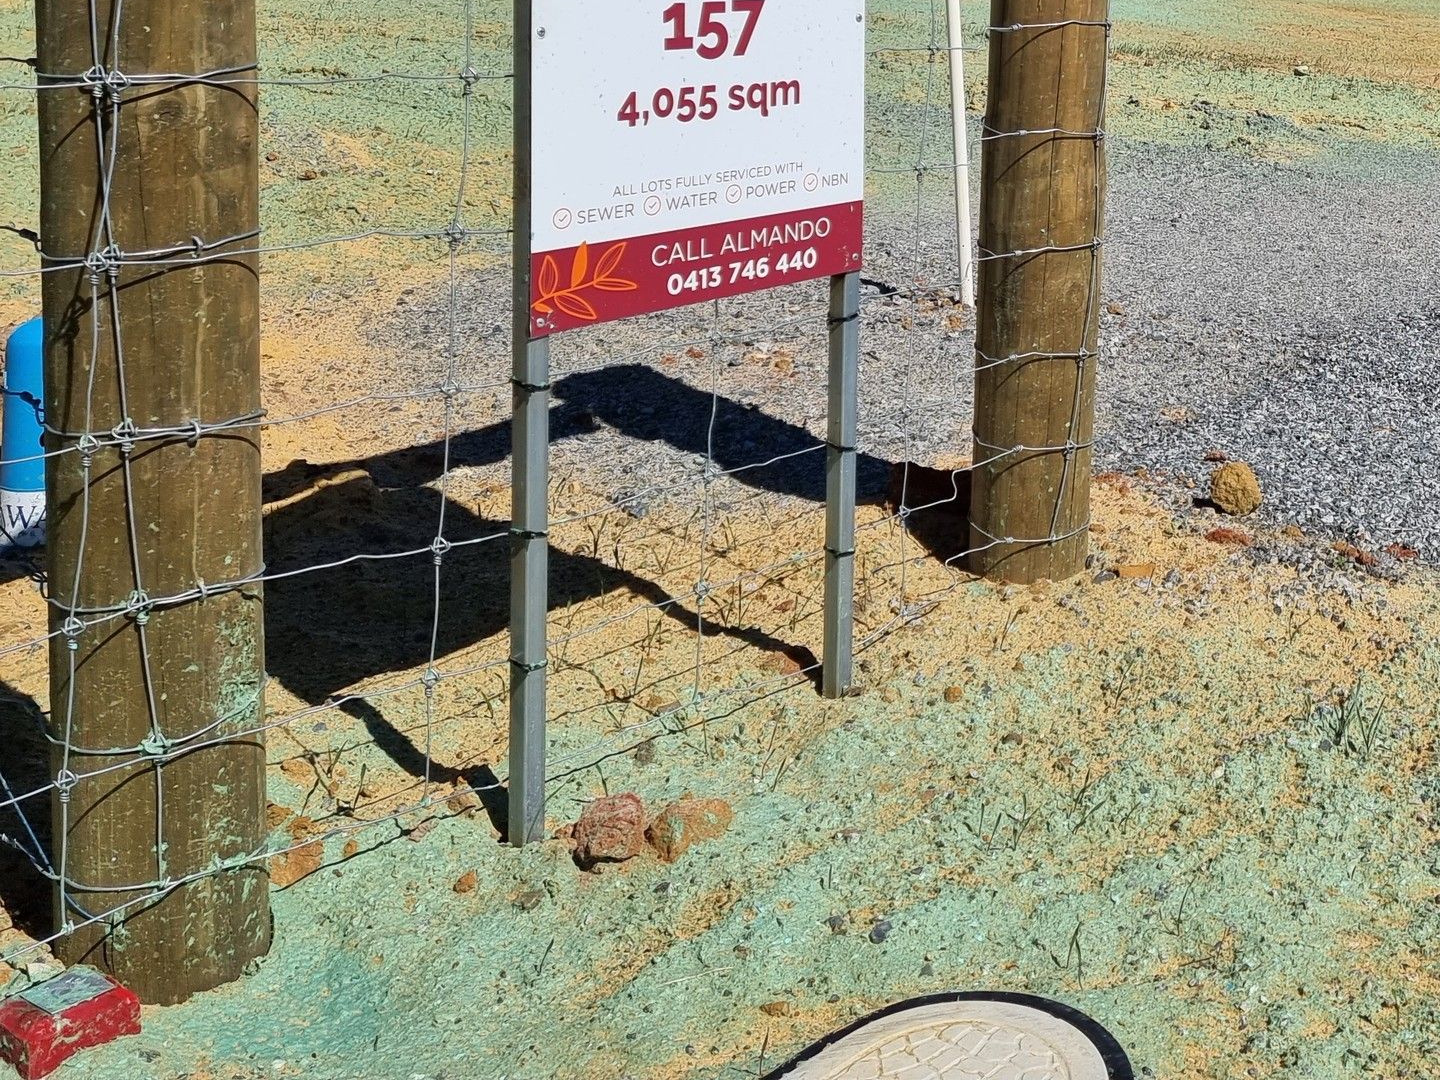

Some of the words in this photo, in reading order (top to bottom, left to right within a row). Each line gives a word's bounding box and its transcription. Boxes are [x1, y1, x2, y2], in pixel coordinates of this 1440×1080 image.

[616, 84, 719, 128] 4,055
[728, 79, 801, 118] sqm
[576, 203, 635, 225] SEWER
[666, 191, 718, 211] WATER
[746, 179, 797, 199] POWER
[821, 172, 850, 188] NBN
[612, 185, 637, 198] ALL
[641, 179, 672, 194] LOTS
[676, 173, 712, 189] FULLY
[716, 165, 773, 184] SERVICED
[775, 161, 804, 174] WITH
[651, 238, 714, 267] CALL
[719, 216, 831, 256] ALMANDO
[666, 266, 723, 296] 0413
[728, 256, 770, 284] 746
[775, 246, 818, 273] 440
